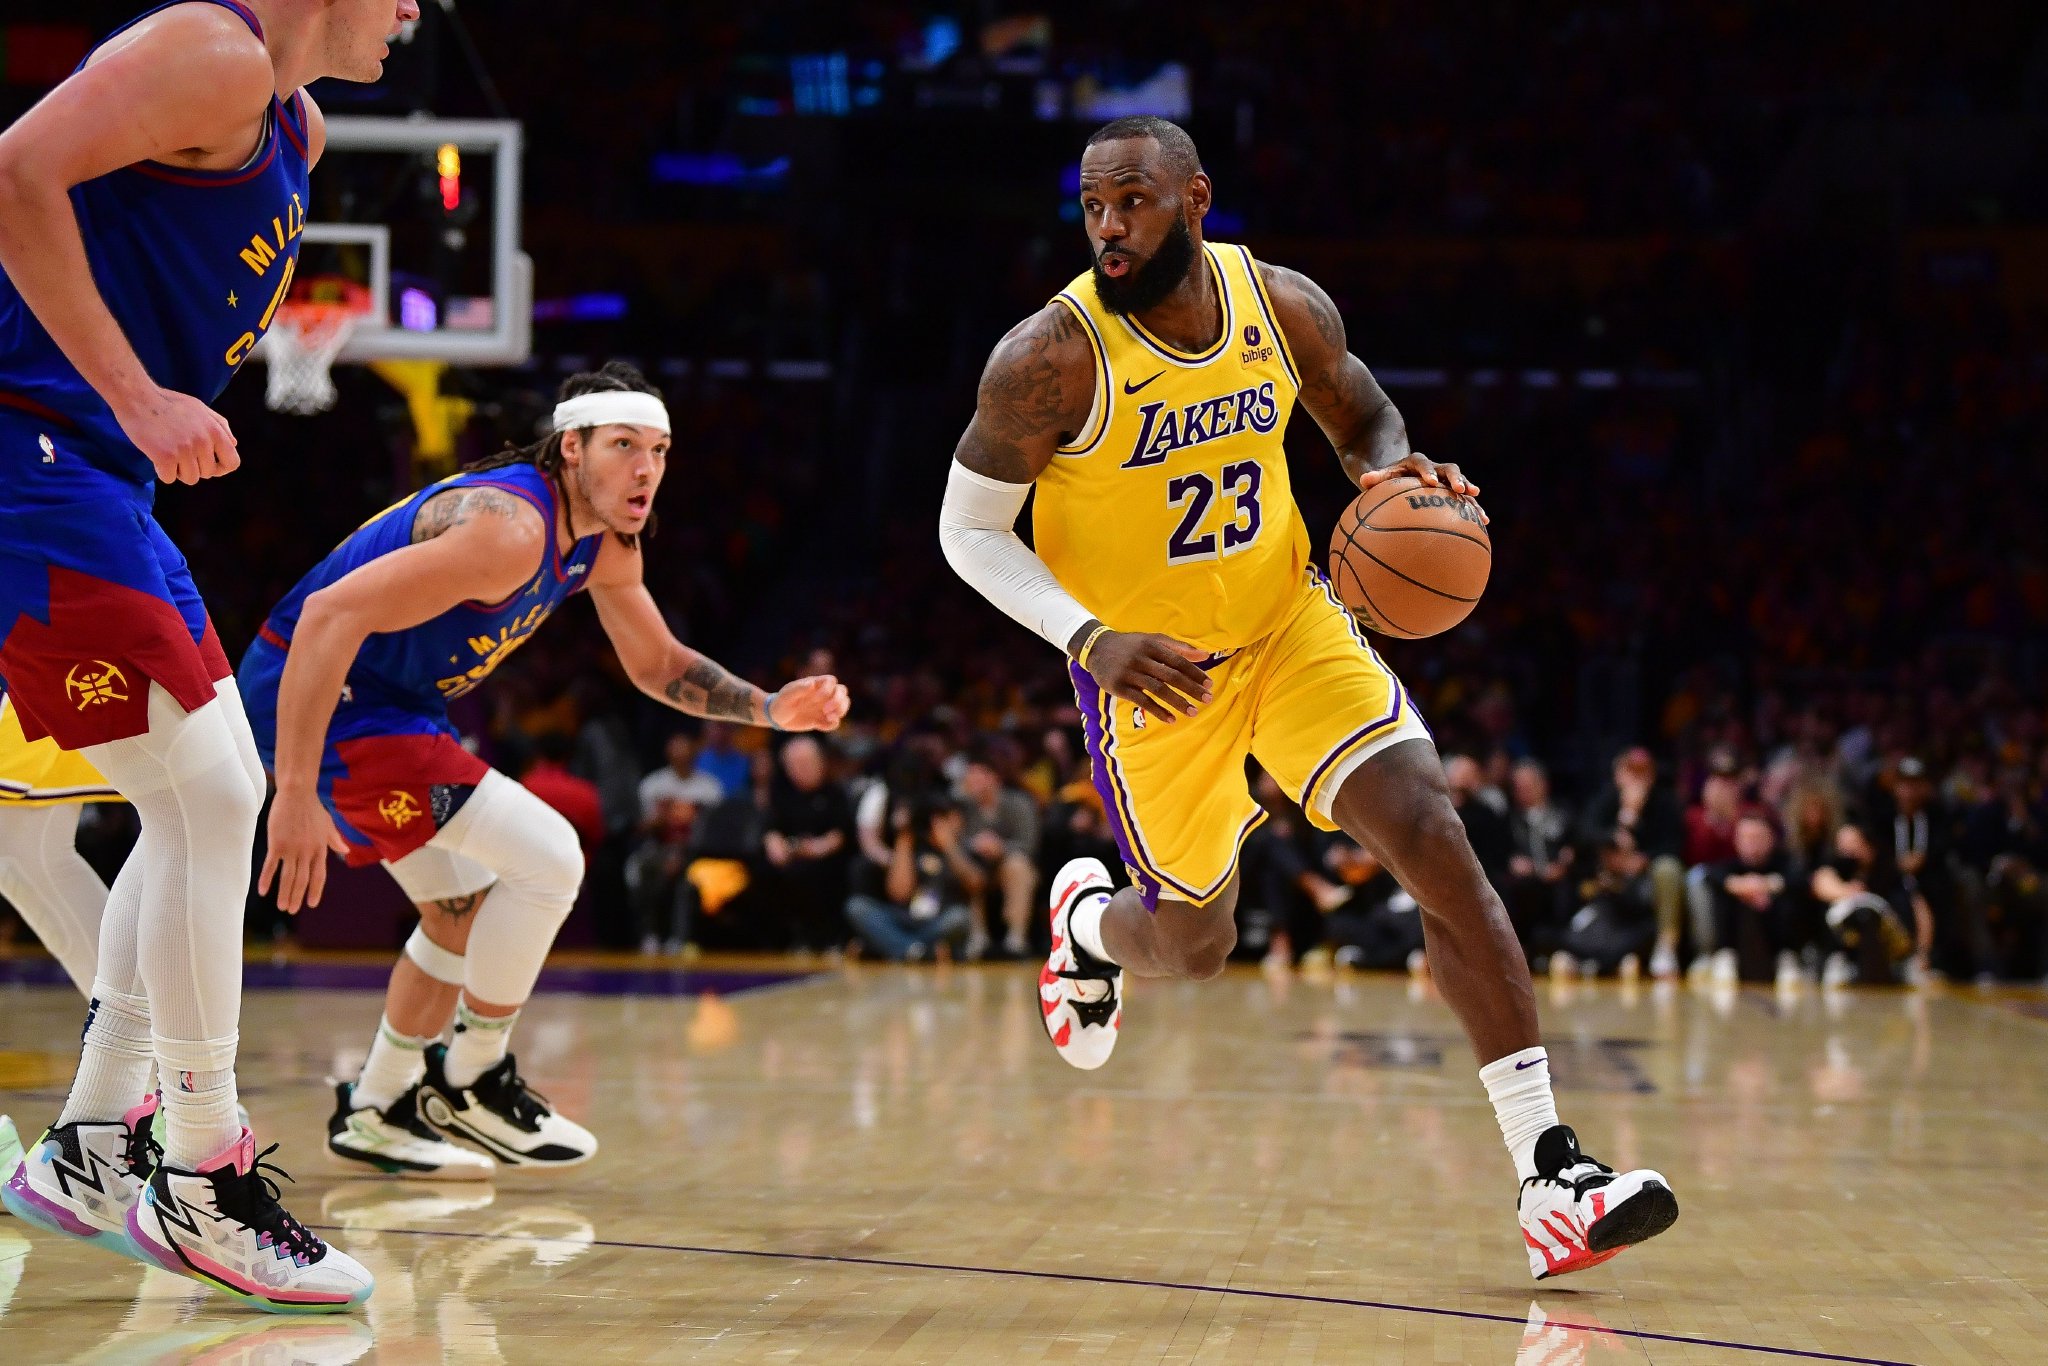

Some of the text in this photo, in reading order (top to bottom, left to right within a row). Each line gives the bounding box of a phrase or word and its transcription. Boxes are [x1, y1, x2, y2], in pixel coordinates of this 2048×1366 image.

[239, 192, 305, 277] MILE
[258, 256, 295, 331] 1
[1241, 346, 1273, 364] bibigo
[1119, 380, 1280, 469] LAKERS
[1166, 457, 1263, 567] 23
